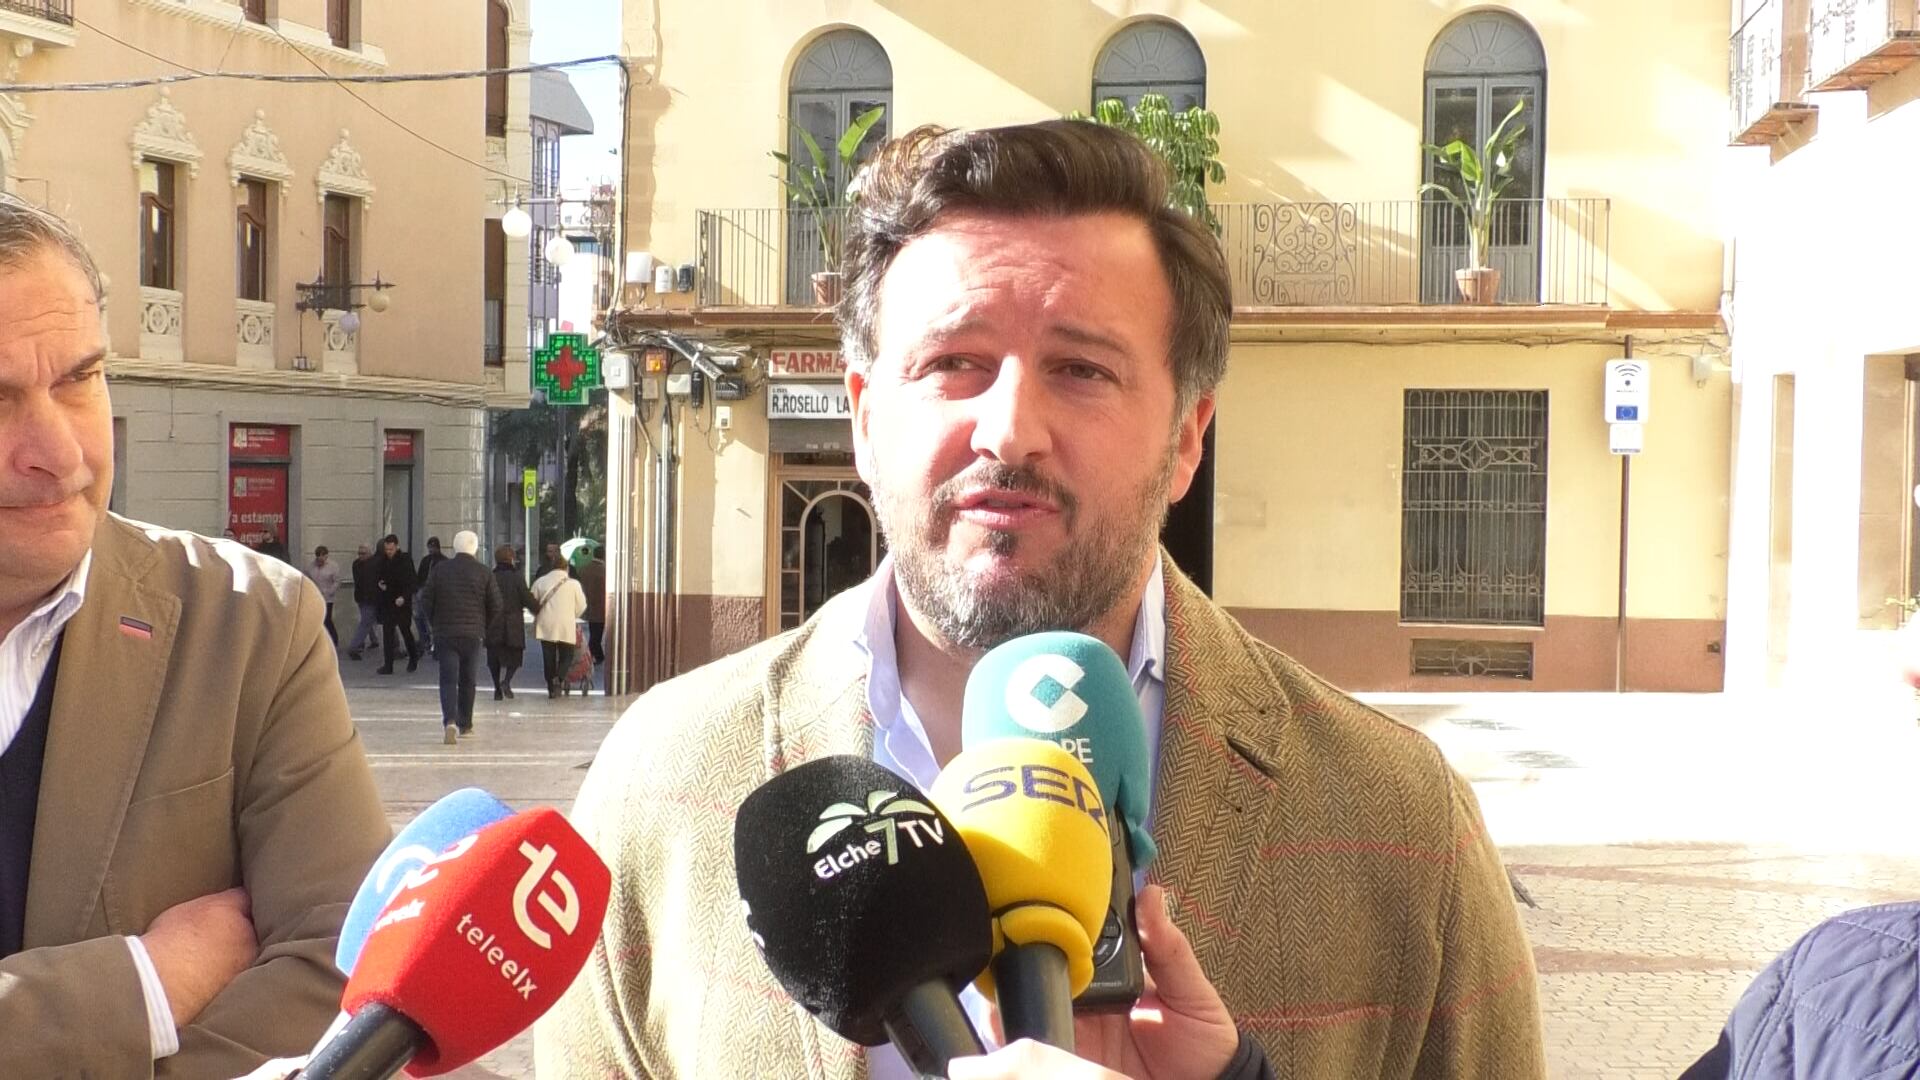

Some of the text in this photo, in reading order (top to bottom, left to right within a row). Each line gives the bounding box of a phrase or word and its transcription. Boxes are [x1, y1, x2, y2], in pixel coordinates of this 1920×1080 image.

[241, 512, 284, 523] estamos
[1060, 738, 1094, 763] PE
[961, 764, 1108, 838] SER
[813, 839, 882, 879] Elche
[455, 913, 537, 1000] teleelx
